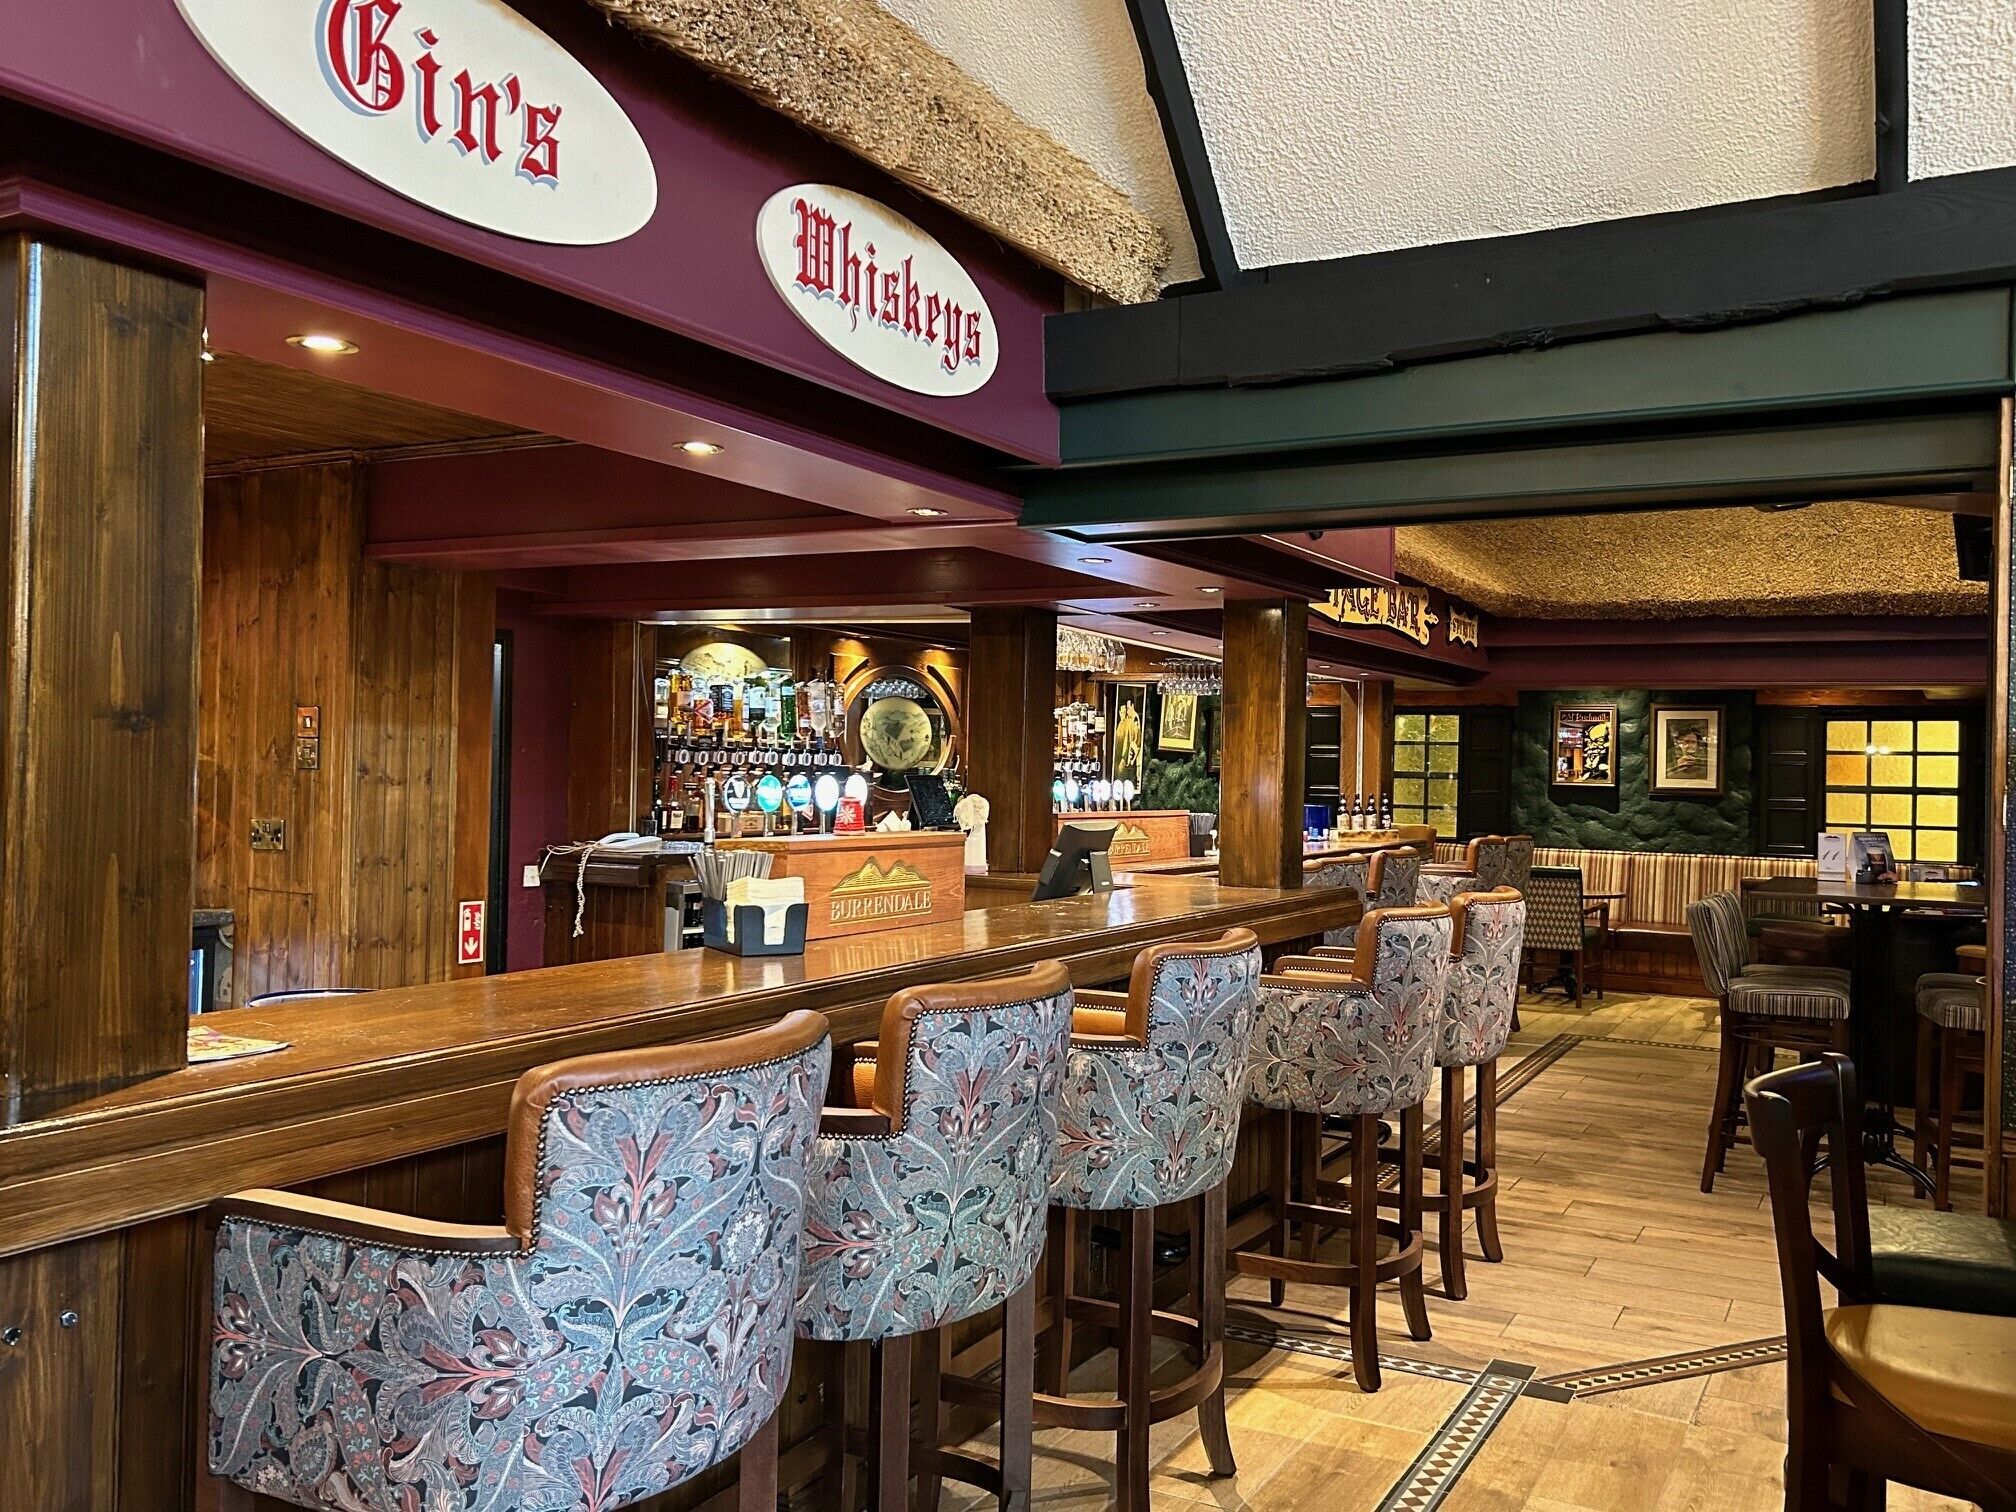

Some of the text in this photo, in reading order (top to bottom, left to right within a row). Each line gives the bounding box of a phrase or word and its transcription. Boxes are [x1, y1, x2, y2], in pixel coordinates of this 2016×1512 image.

[315, 0, 562, 190] Gin's
[790, 198, 982, 376] Whiskeys
[1382, 587, 1421, 637] BAR
[830, 890, 932, 921] BURRENDALE
